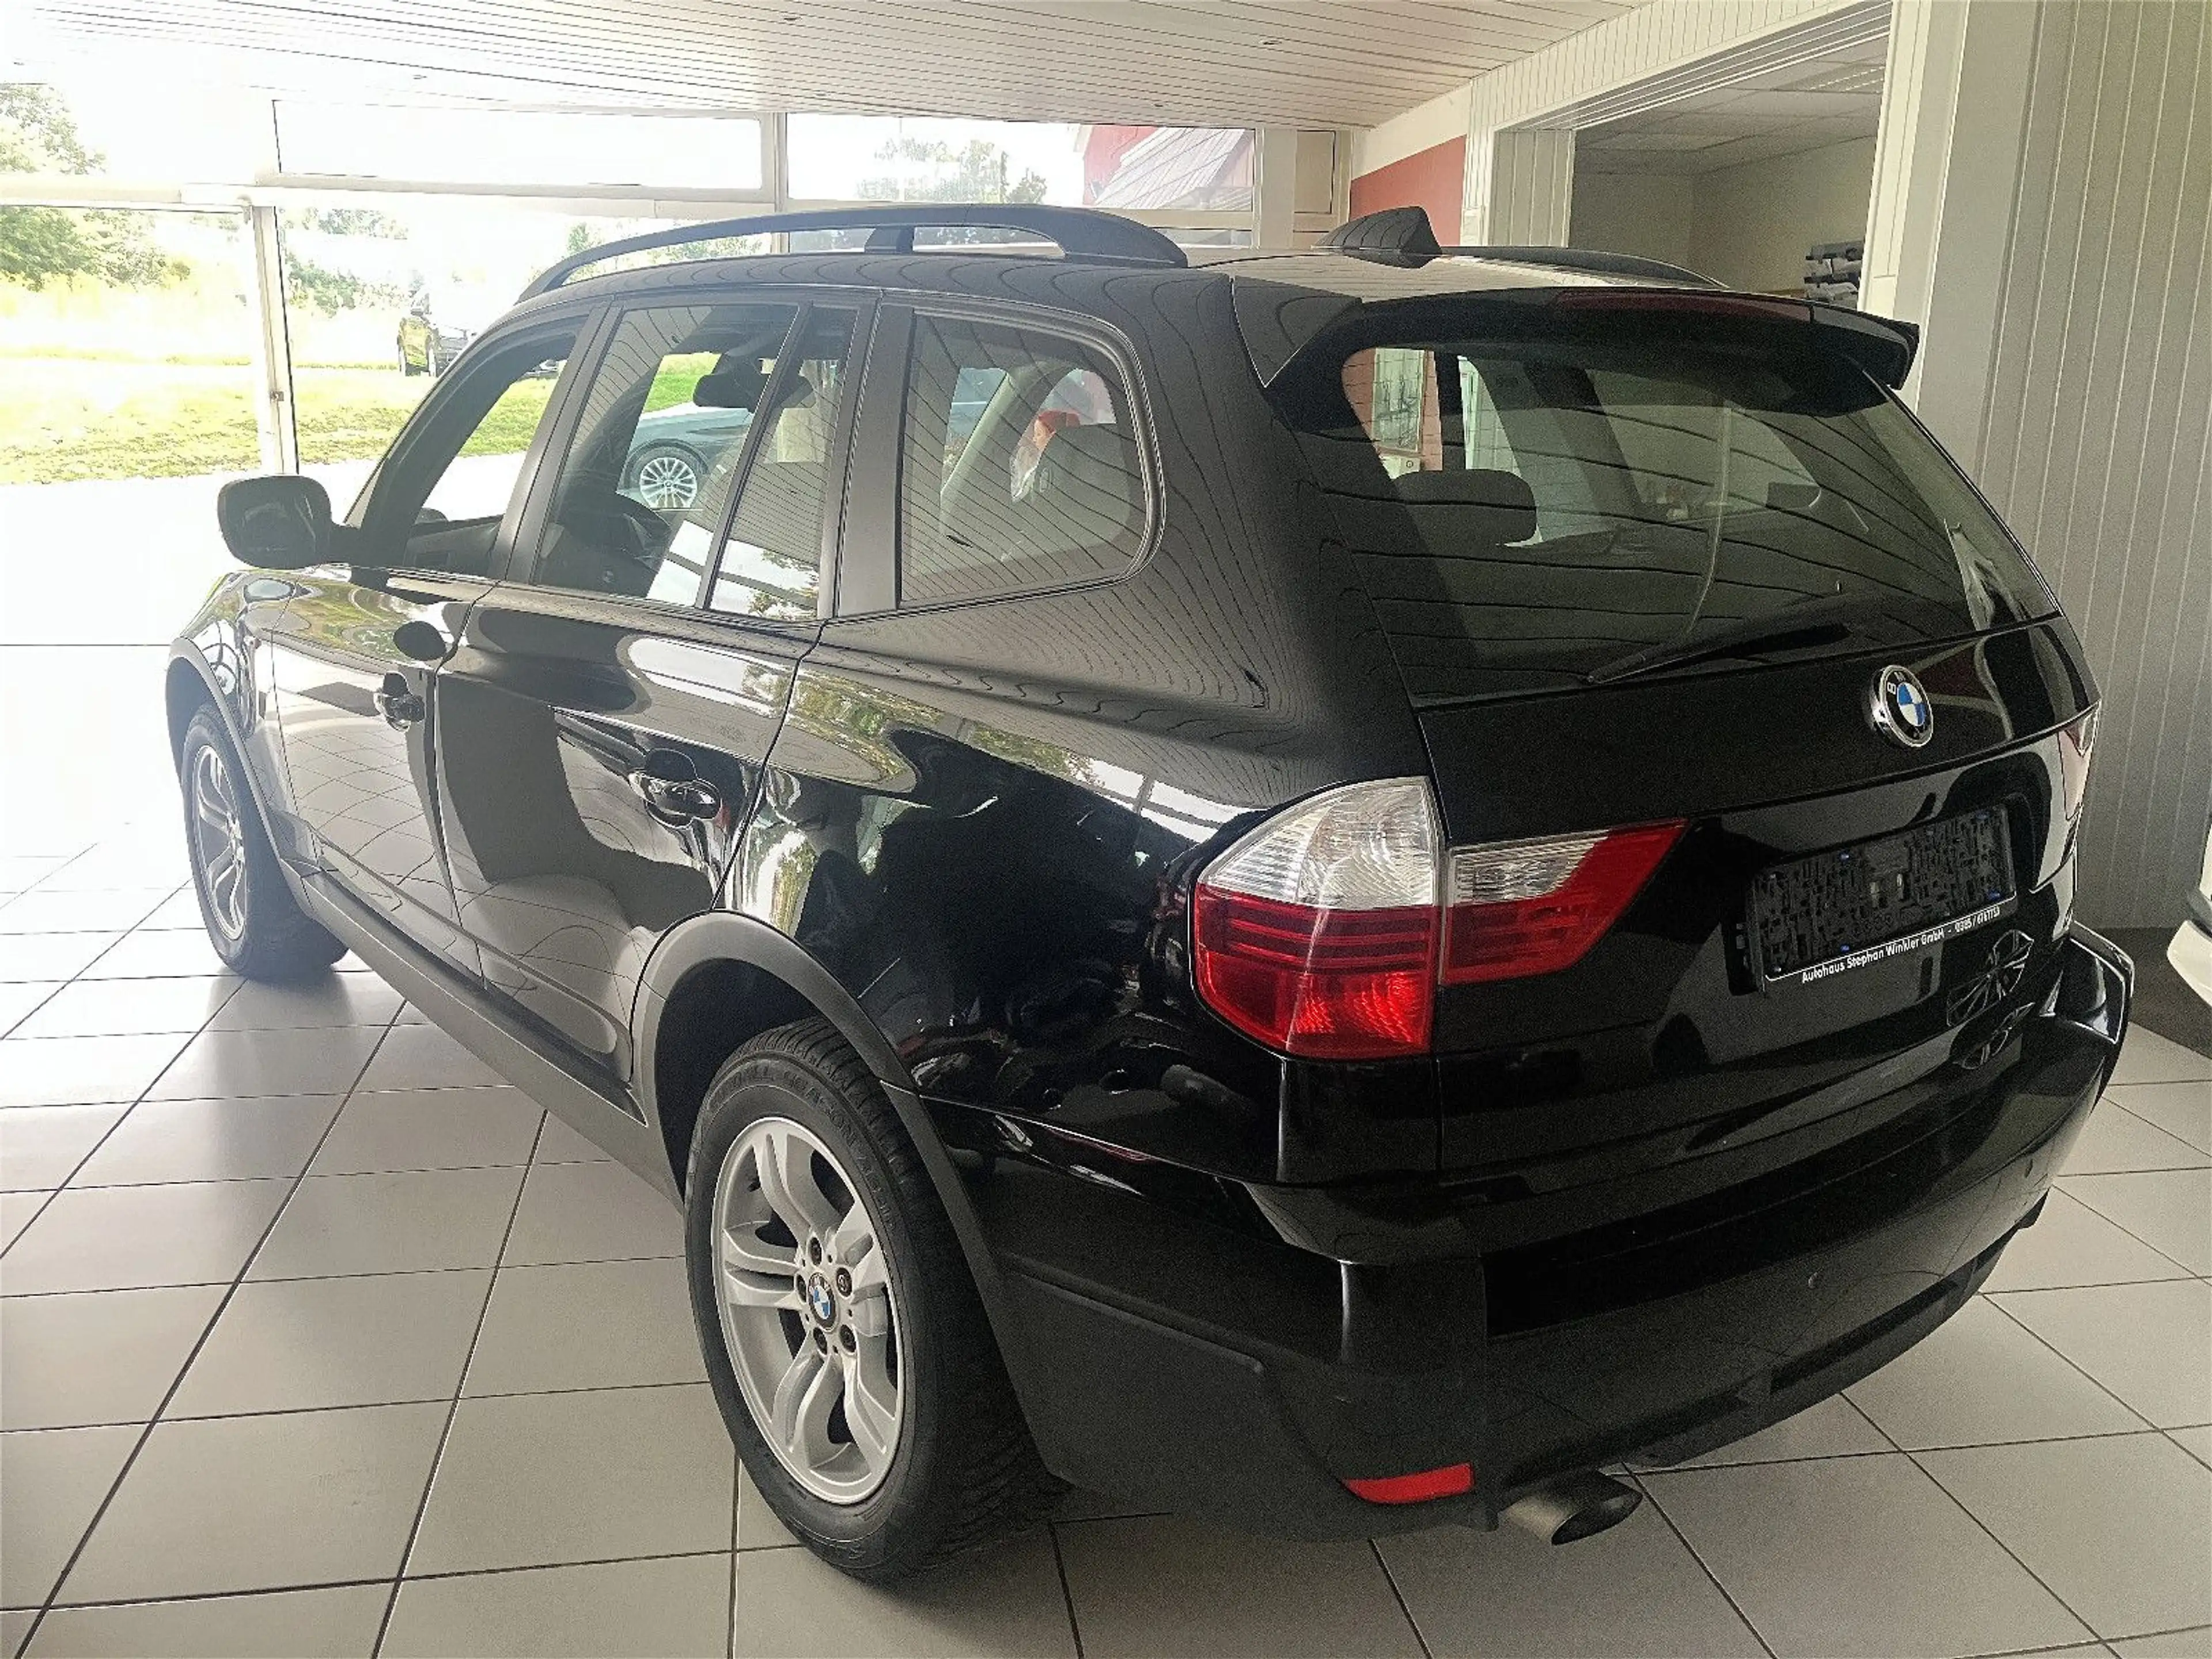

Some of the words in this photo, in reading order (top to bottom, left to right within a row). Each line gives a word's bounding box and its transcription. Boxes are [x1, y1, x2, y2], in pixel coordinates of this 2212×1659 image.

[1802, 963, 1844, 984] Autohaus
[1847, 949, 1884, 968] Stephan
[1885, 939, 1919, 956] Winkler
[1921, 928, 1945, 945] GmbH
